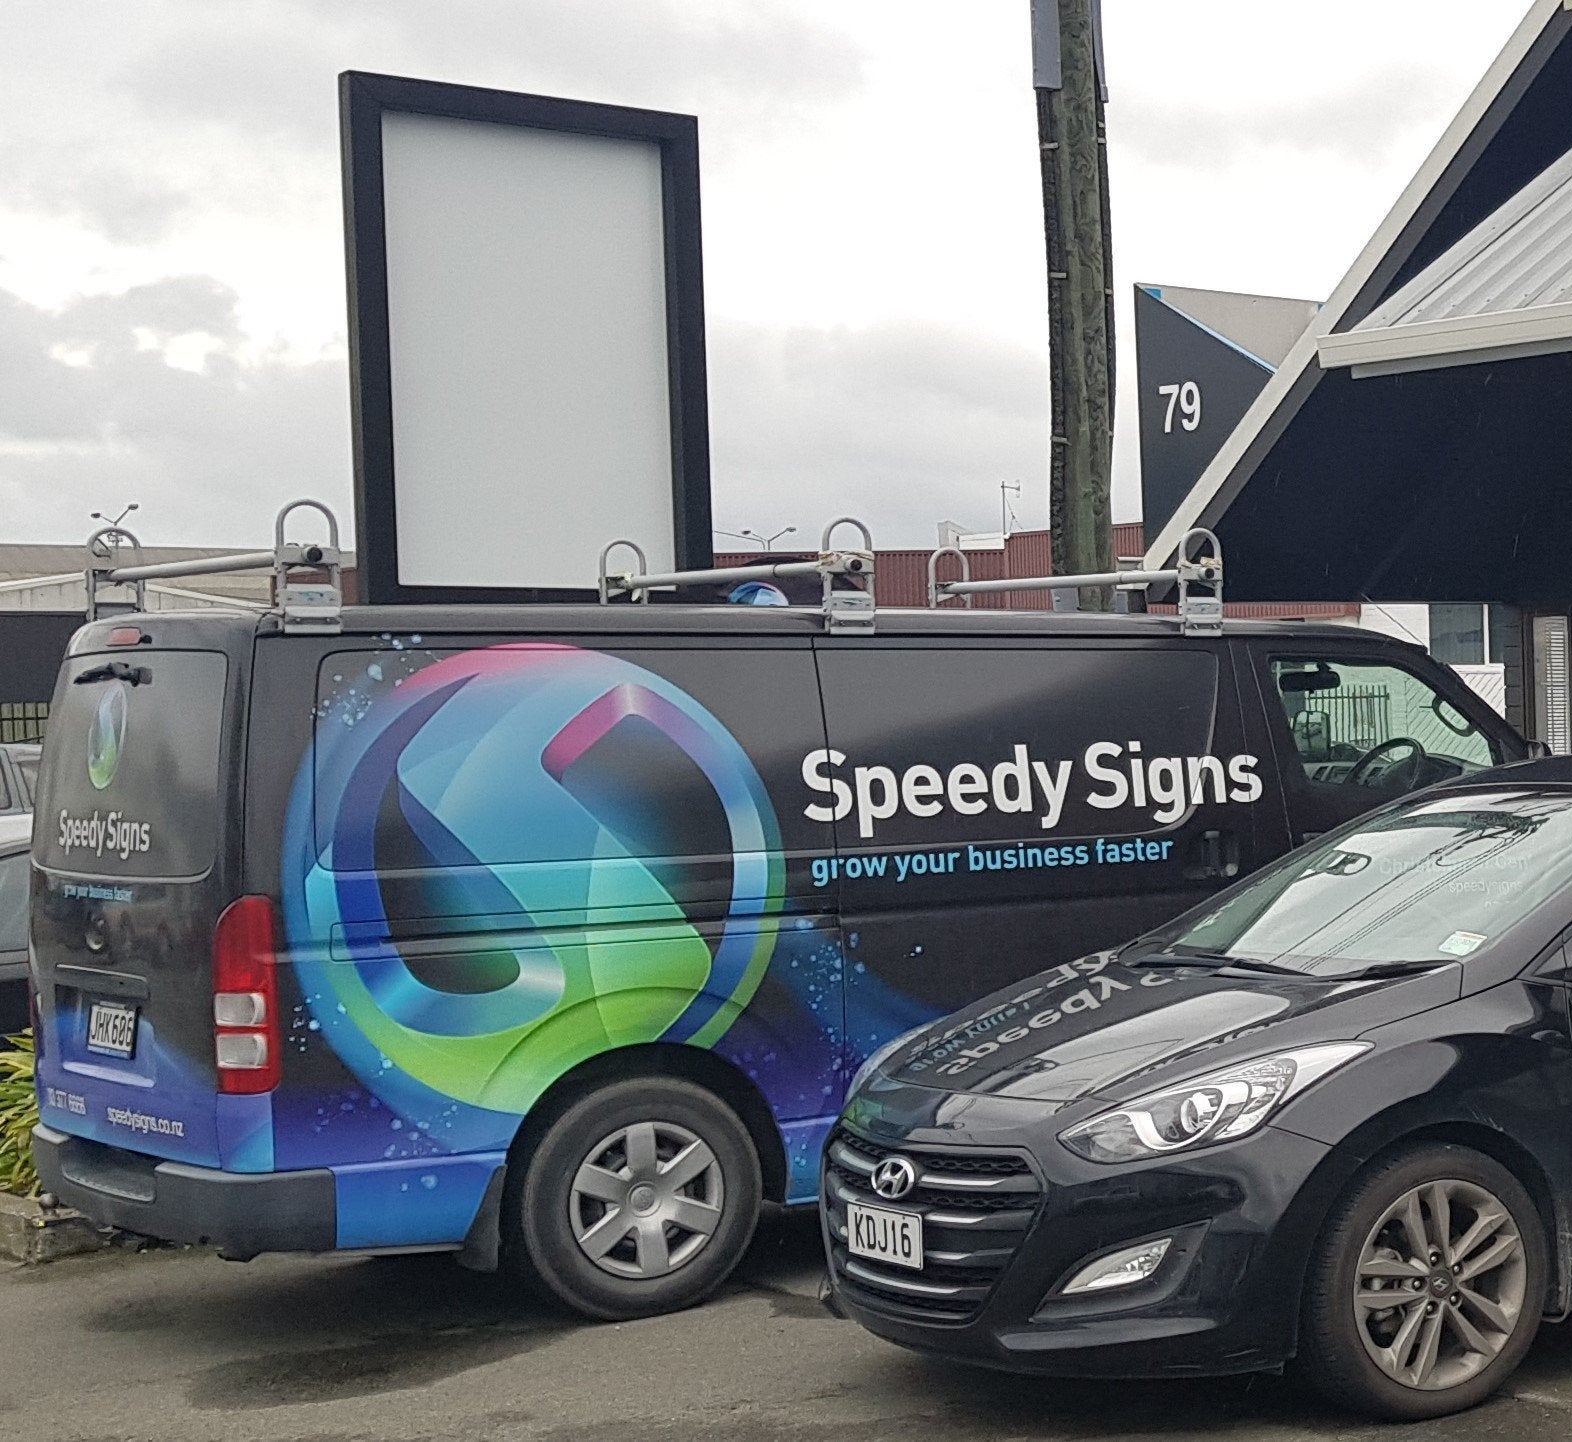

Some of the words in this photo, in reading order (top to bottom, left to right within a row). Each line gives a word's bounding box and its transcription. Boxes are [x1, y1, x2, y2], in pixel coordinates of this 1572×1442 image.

[1159, 381, 1201, 433] 79
[802, 744, 1073, 838] Speedy
[1085, 741, 1263, 824] Signs
[58, 809, 106, 857] Speedy
[106, 811, 150, 860] Signs
[811, 856, 888, 887] grow
[896, 850, 961, 882] your
[967, 842, 1089, 872] business
[1096, 837, 1174, 864] faster
[91, 1010, 134, 1048] JHK606
[854, 1211, 912, 1258] KDJ16
